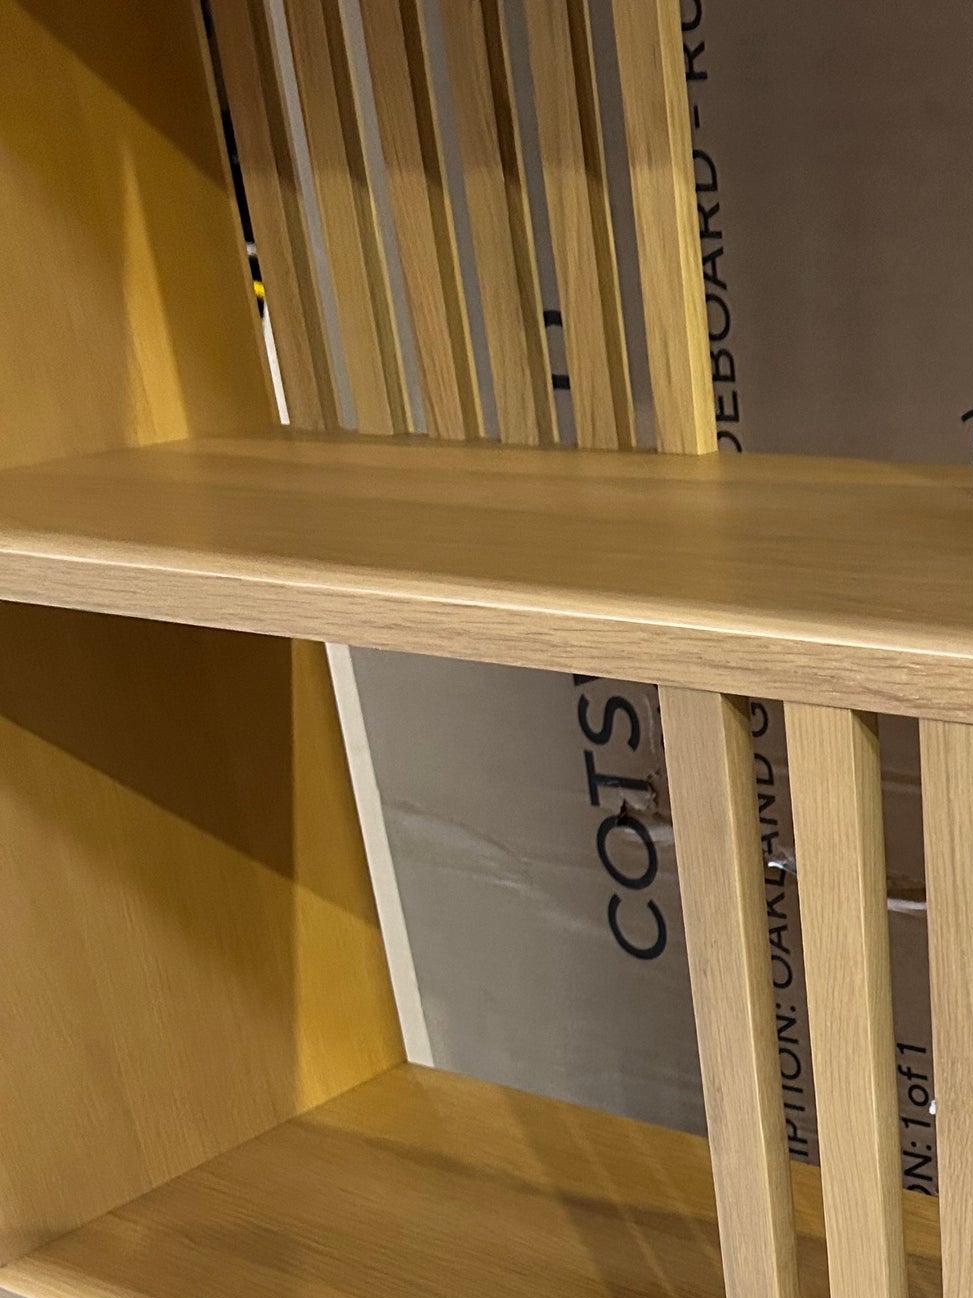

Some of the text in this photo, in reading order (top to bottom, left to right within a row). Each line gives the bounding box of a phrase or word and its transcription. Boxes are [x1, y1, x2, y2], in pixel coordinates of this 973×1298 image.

[571, 673, 667, 960] COTS
[896, 1041, 928, 1056] 1
[897, 1064, 930, 1107] of
[900, 1115, 931, 1130] 1
